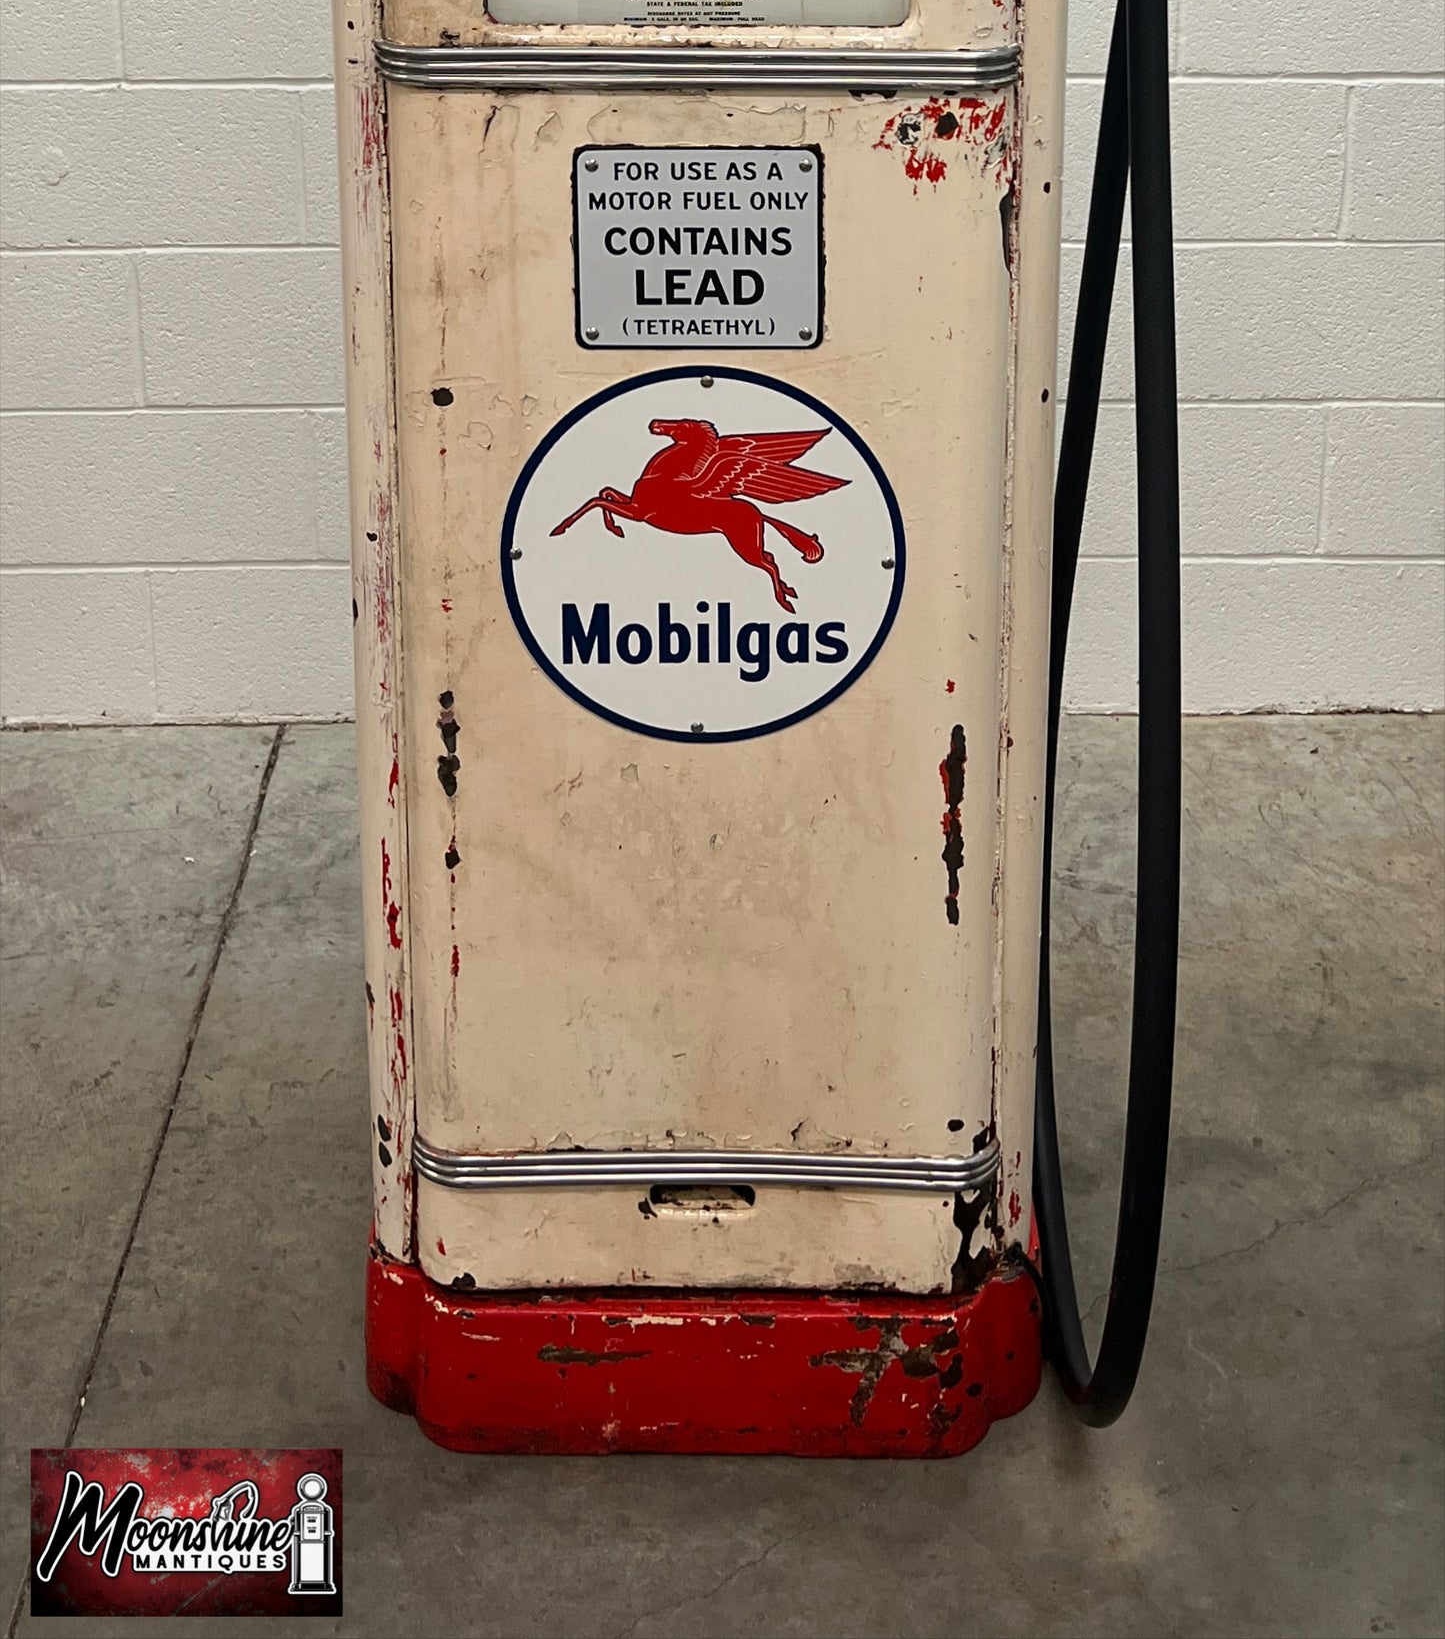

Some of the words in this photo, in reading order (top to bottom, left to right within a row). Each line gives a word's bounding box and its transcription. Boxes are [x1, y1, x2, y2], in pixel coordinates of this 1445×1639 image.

[613, 162, 659, 181] FOR
[670, 162, 717, 181] USE
[725, 162, 757, 181] AS
[767, 162, 783, 181] A
[588, 191, 672, 211] MOTOR
[683, 191, 741, 210] FUEL
[750, 191, 809, 210] ONLY
[604, 226, 793, 256] CONTAINS
[635, 269, 765, 306] LEAD
[622, 317, 776, 337] (TETRAETHYL)
[561, 602, 850, 683] Mobilgas
